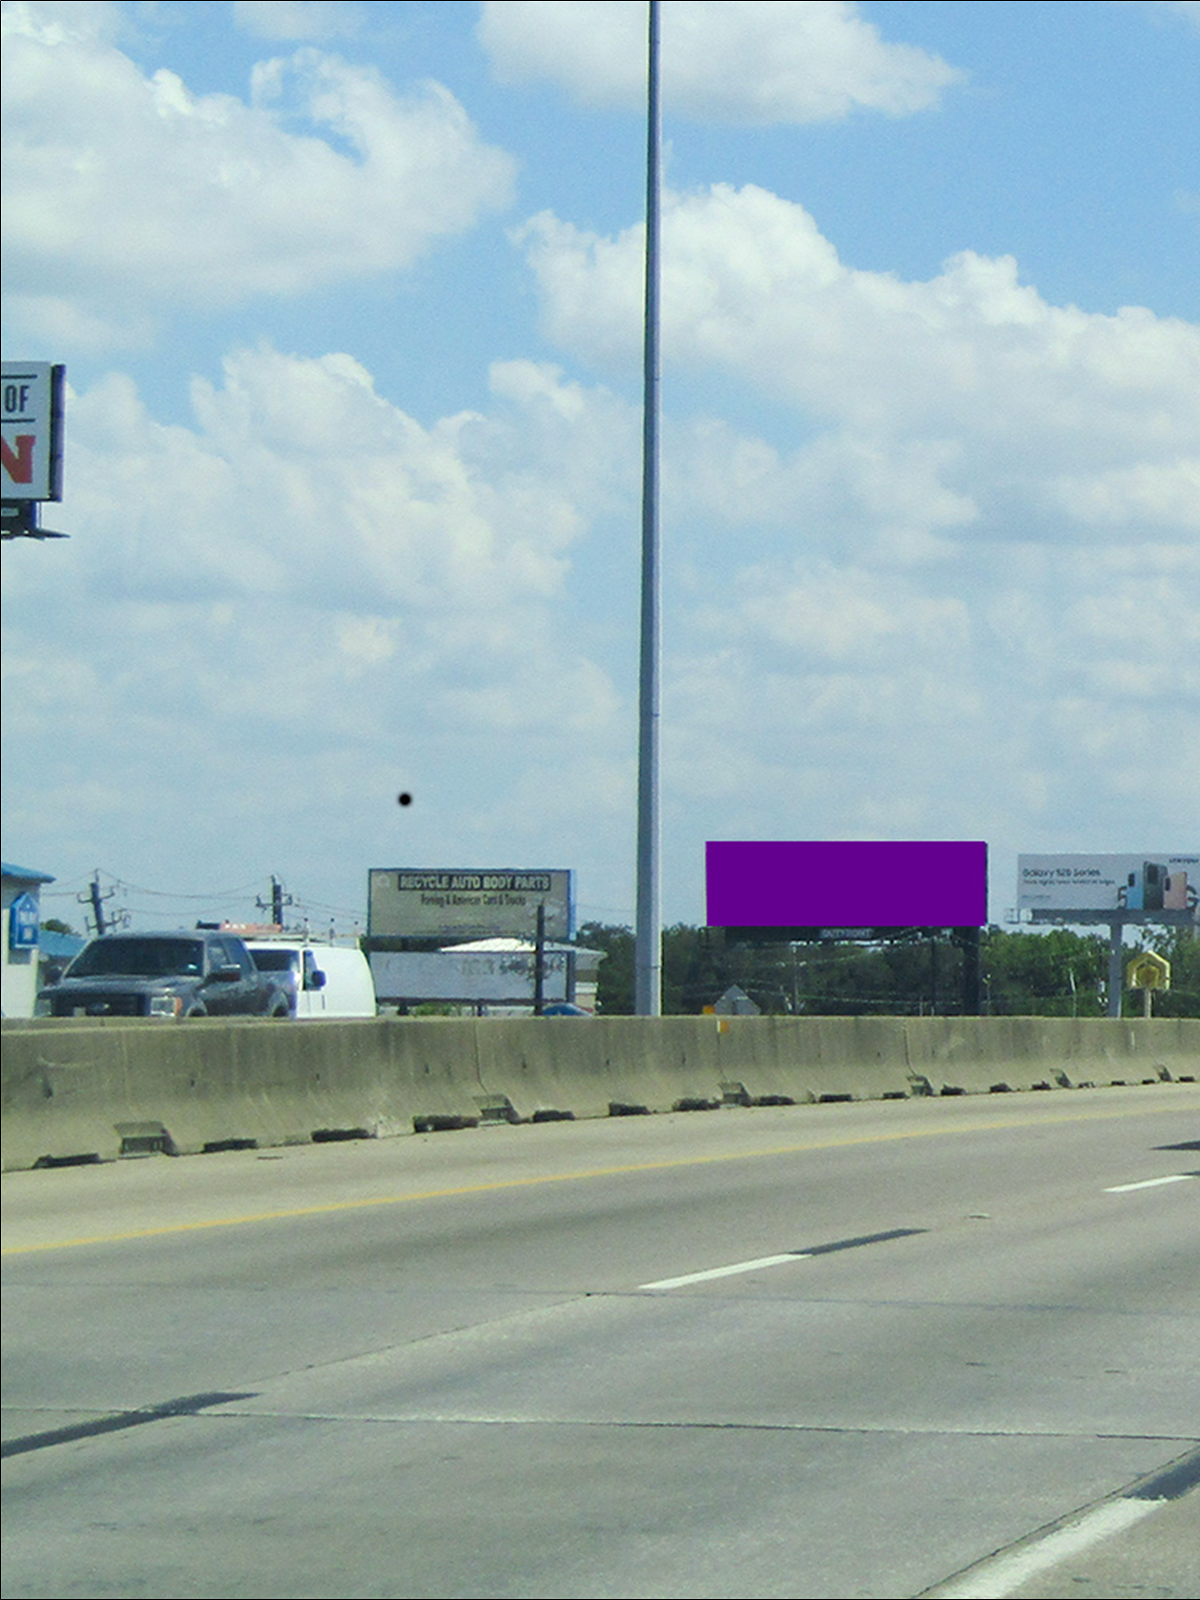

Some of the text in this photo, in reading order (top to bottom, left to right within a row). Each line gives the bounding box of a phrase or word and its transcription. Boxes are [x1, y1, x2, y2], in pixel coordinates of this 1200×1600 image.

[5, 385, 30, 412] OF
[400, 874, 550, 889] RECYCLE AUTO BODY PARTS
